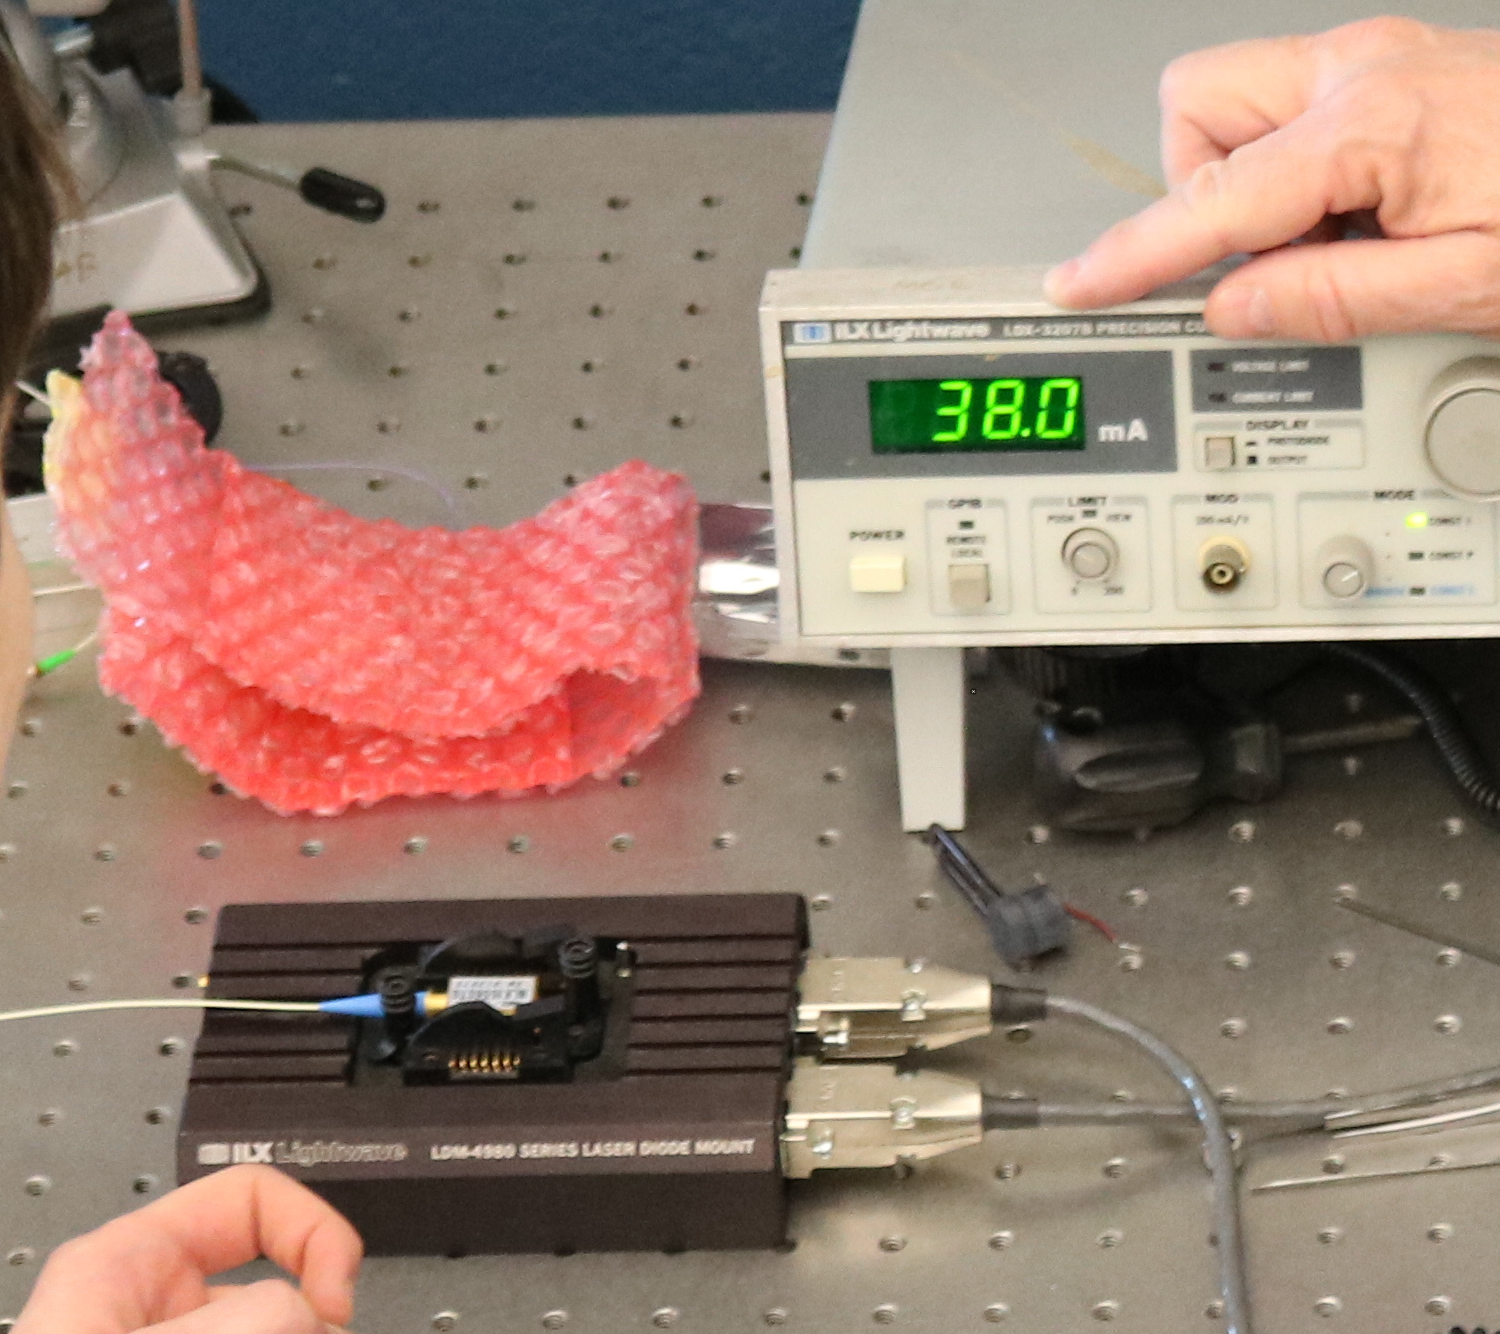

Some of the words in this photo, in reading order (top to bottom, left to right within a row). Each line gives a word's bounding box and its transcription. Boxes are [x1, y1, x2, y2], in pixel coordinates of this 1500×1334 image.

[835, 322, 870, 340] ILX
[872, 321, 991, 343] Lightwave
[932, 379, 1080, 442] 38.0
[1098, 418, 1148, 442] mA
[1246, 420, 1310, 431] DISPLAY
[1205, 493, 1239, 504] MOD
[1374, 489, 1415, 500] MODE
[849, 530, 905, 543] POWER
[232, 1141, 274, 1164] ILX
[276, 1139, 408, 1167] Lightwave
[518, 1142, 579, 1158] SERIES
[581, 1141, 637, 1157] LASER
[638, 1140, 691, 1156] DIODE
[693, 1139, 756, 1155] MOUNT
